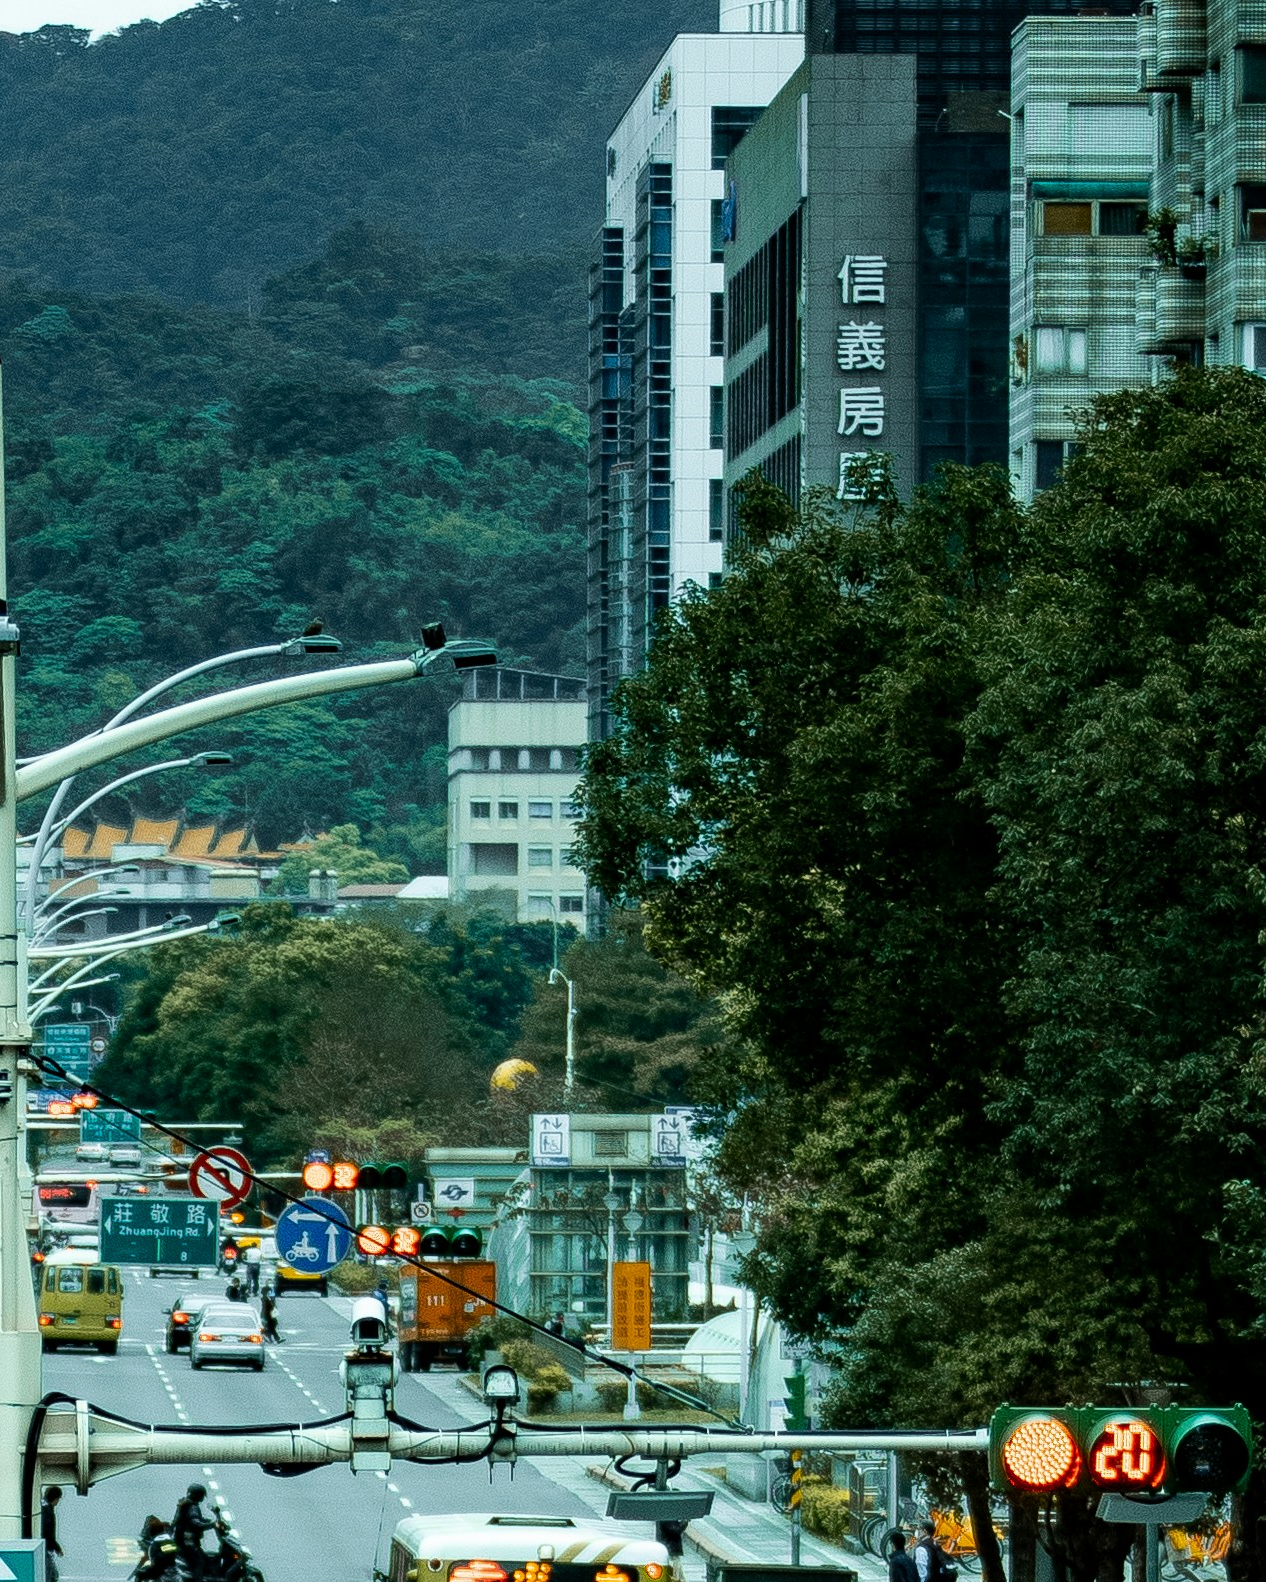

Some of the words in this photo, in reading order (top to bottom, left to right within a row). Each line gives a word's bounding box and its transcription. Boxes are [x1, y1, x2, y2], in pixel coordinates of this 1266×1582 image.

[113, 1202, 206, 1225] 莊敬路
[119, 1225, 183, 1239] ZhuangJing
[185, 1227, 201, 1237] Rd.
[180, 1251, 188, 1262] 8
[1095, 1423, 1151, 1480] 20
